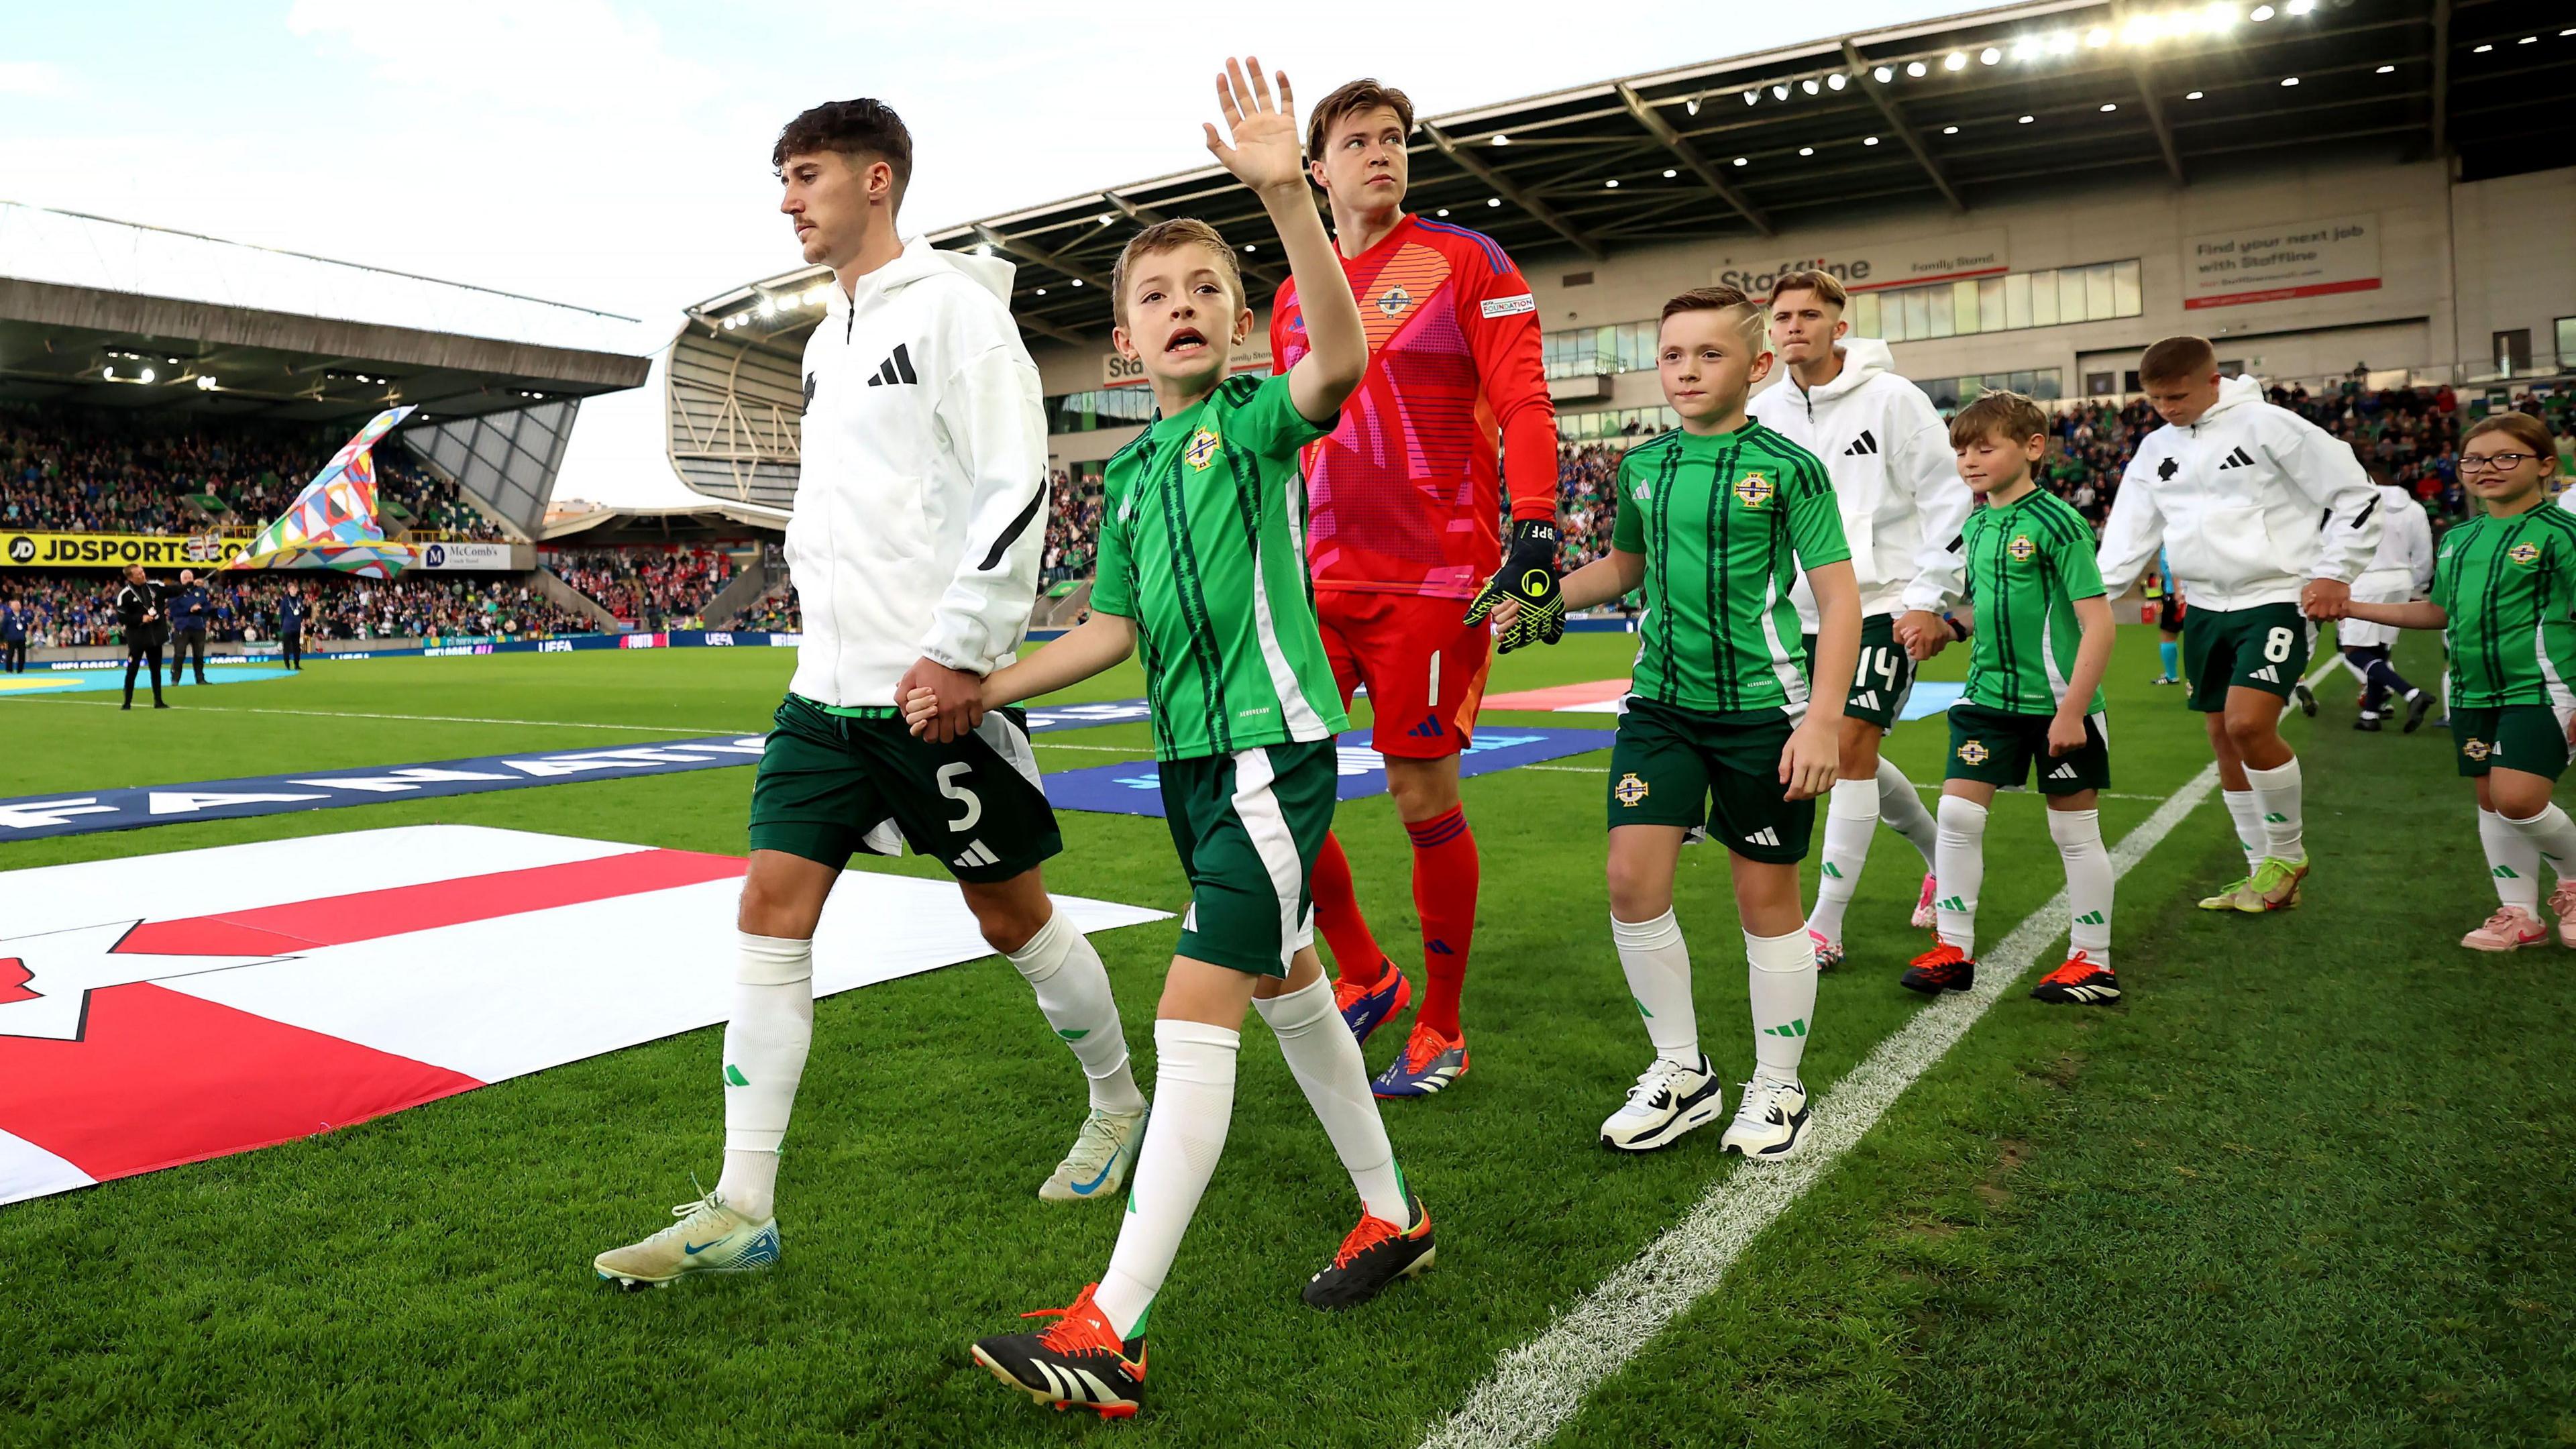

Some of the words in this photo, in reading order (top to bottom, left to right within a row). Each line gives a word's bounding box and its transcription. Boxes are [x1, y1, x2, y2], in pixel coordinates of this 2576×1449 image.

[1483, 299, 1533, 312] FOUNDATION
[1109, 357, 1144, 378] Sta
[11, 543, 34, 559] JD
[429, 549, 442, 564] M
[449, 546, 498, 557] McComb's
[2264, 627, 2294, 663] 8
[1428, 649, 1440, 706] 1
[1856, 646, 1900, 692] 14
[936, 761, 983, 833] 5
